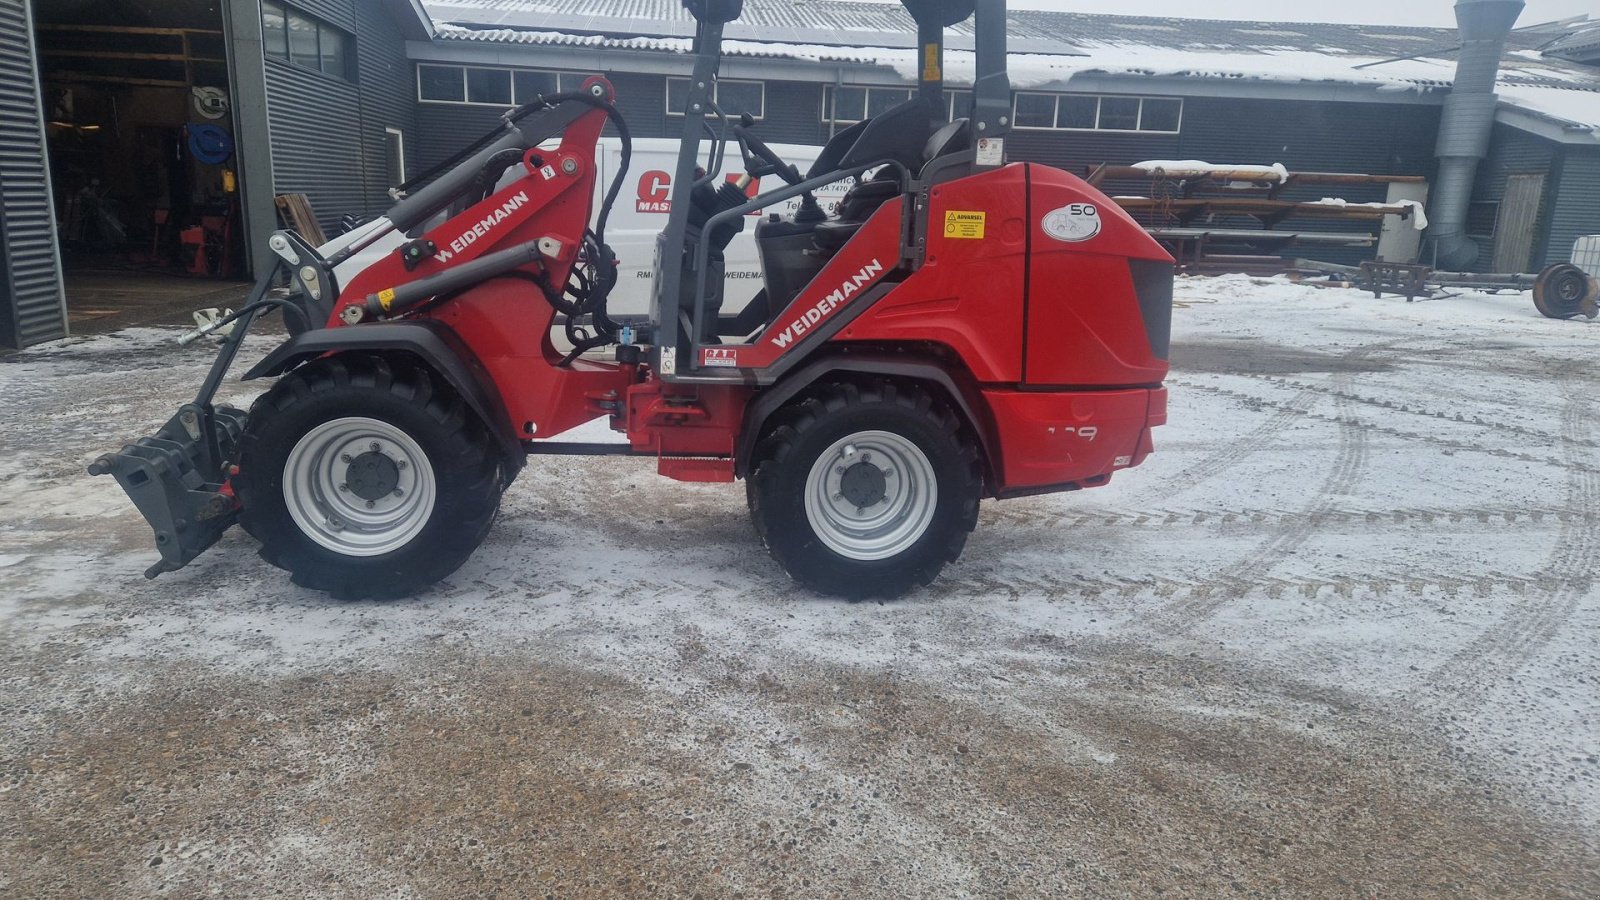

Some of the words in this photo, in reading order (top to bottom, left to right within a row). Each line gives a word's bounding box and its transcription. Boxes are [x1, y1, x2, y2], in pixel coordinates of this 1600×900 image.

[433, 190, 529, 264] WEIDEMANN
[1070, 204, 1096, 216] 50
[770, 258, 883, 348] WEIDEMANN
